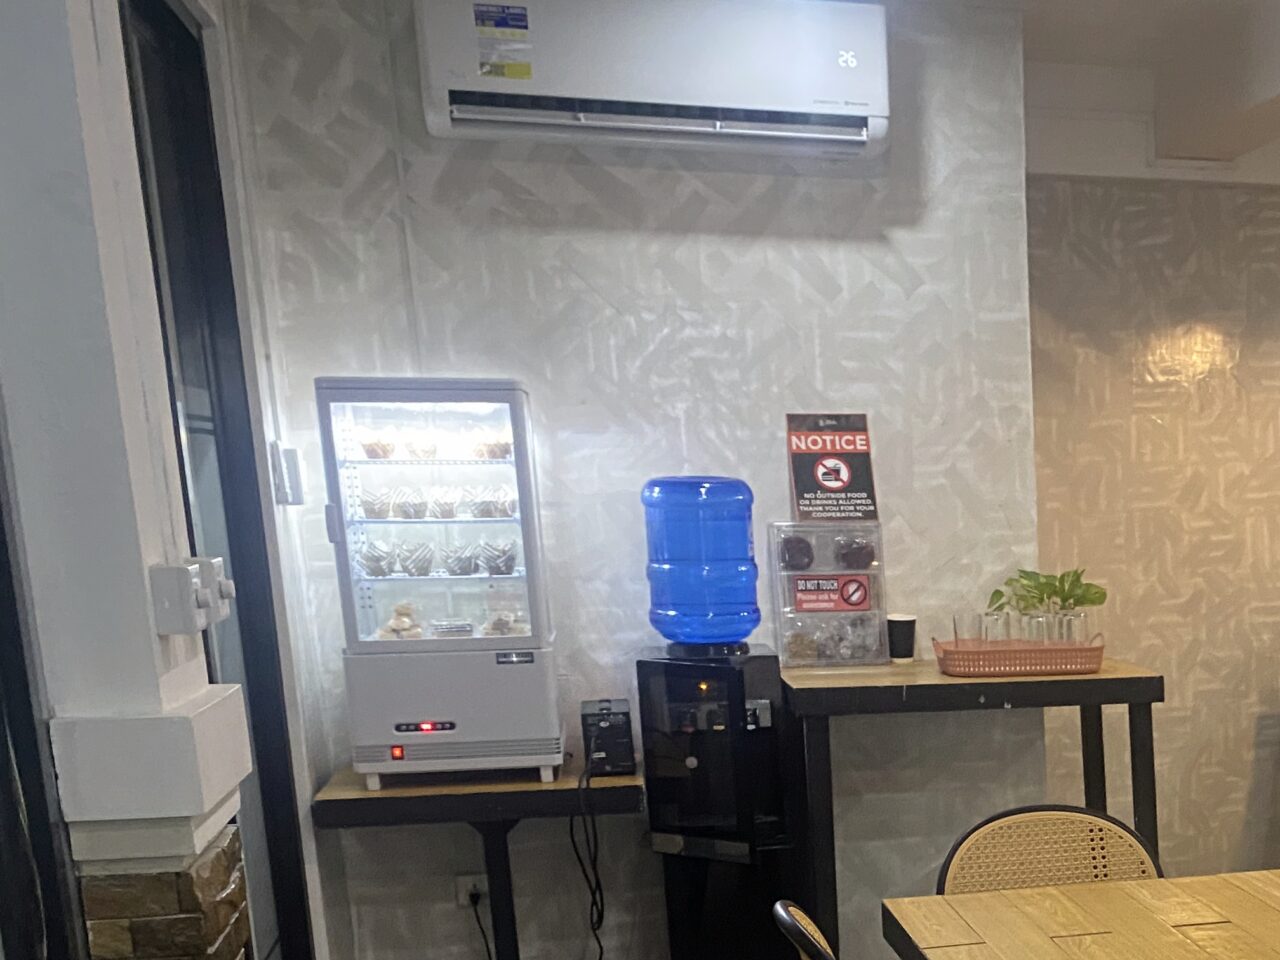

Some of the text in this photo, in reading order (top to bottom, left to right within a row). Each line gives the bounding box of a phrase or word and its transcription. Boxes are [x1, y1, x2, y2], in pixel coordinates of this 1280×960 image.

[838, 50, 857, 68] 26
[791, 435, 868, 450] NOTICE
[797, 580, 838, 590] DO NOT TOUCH
